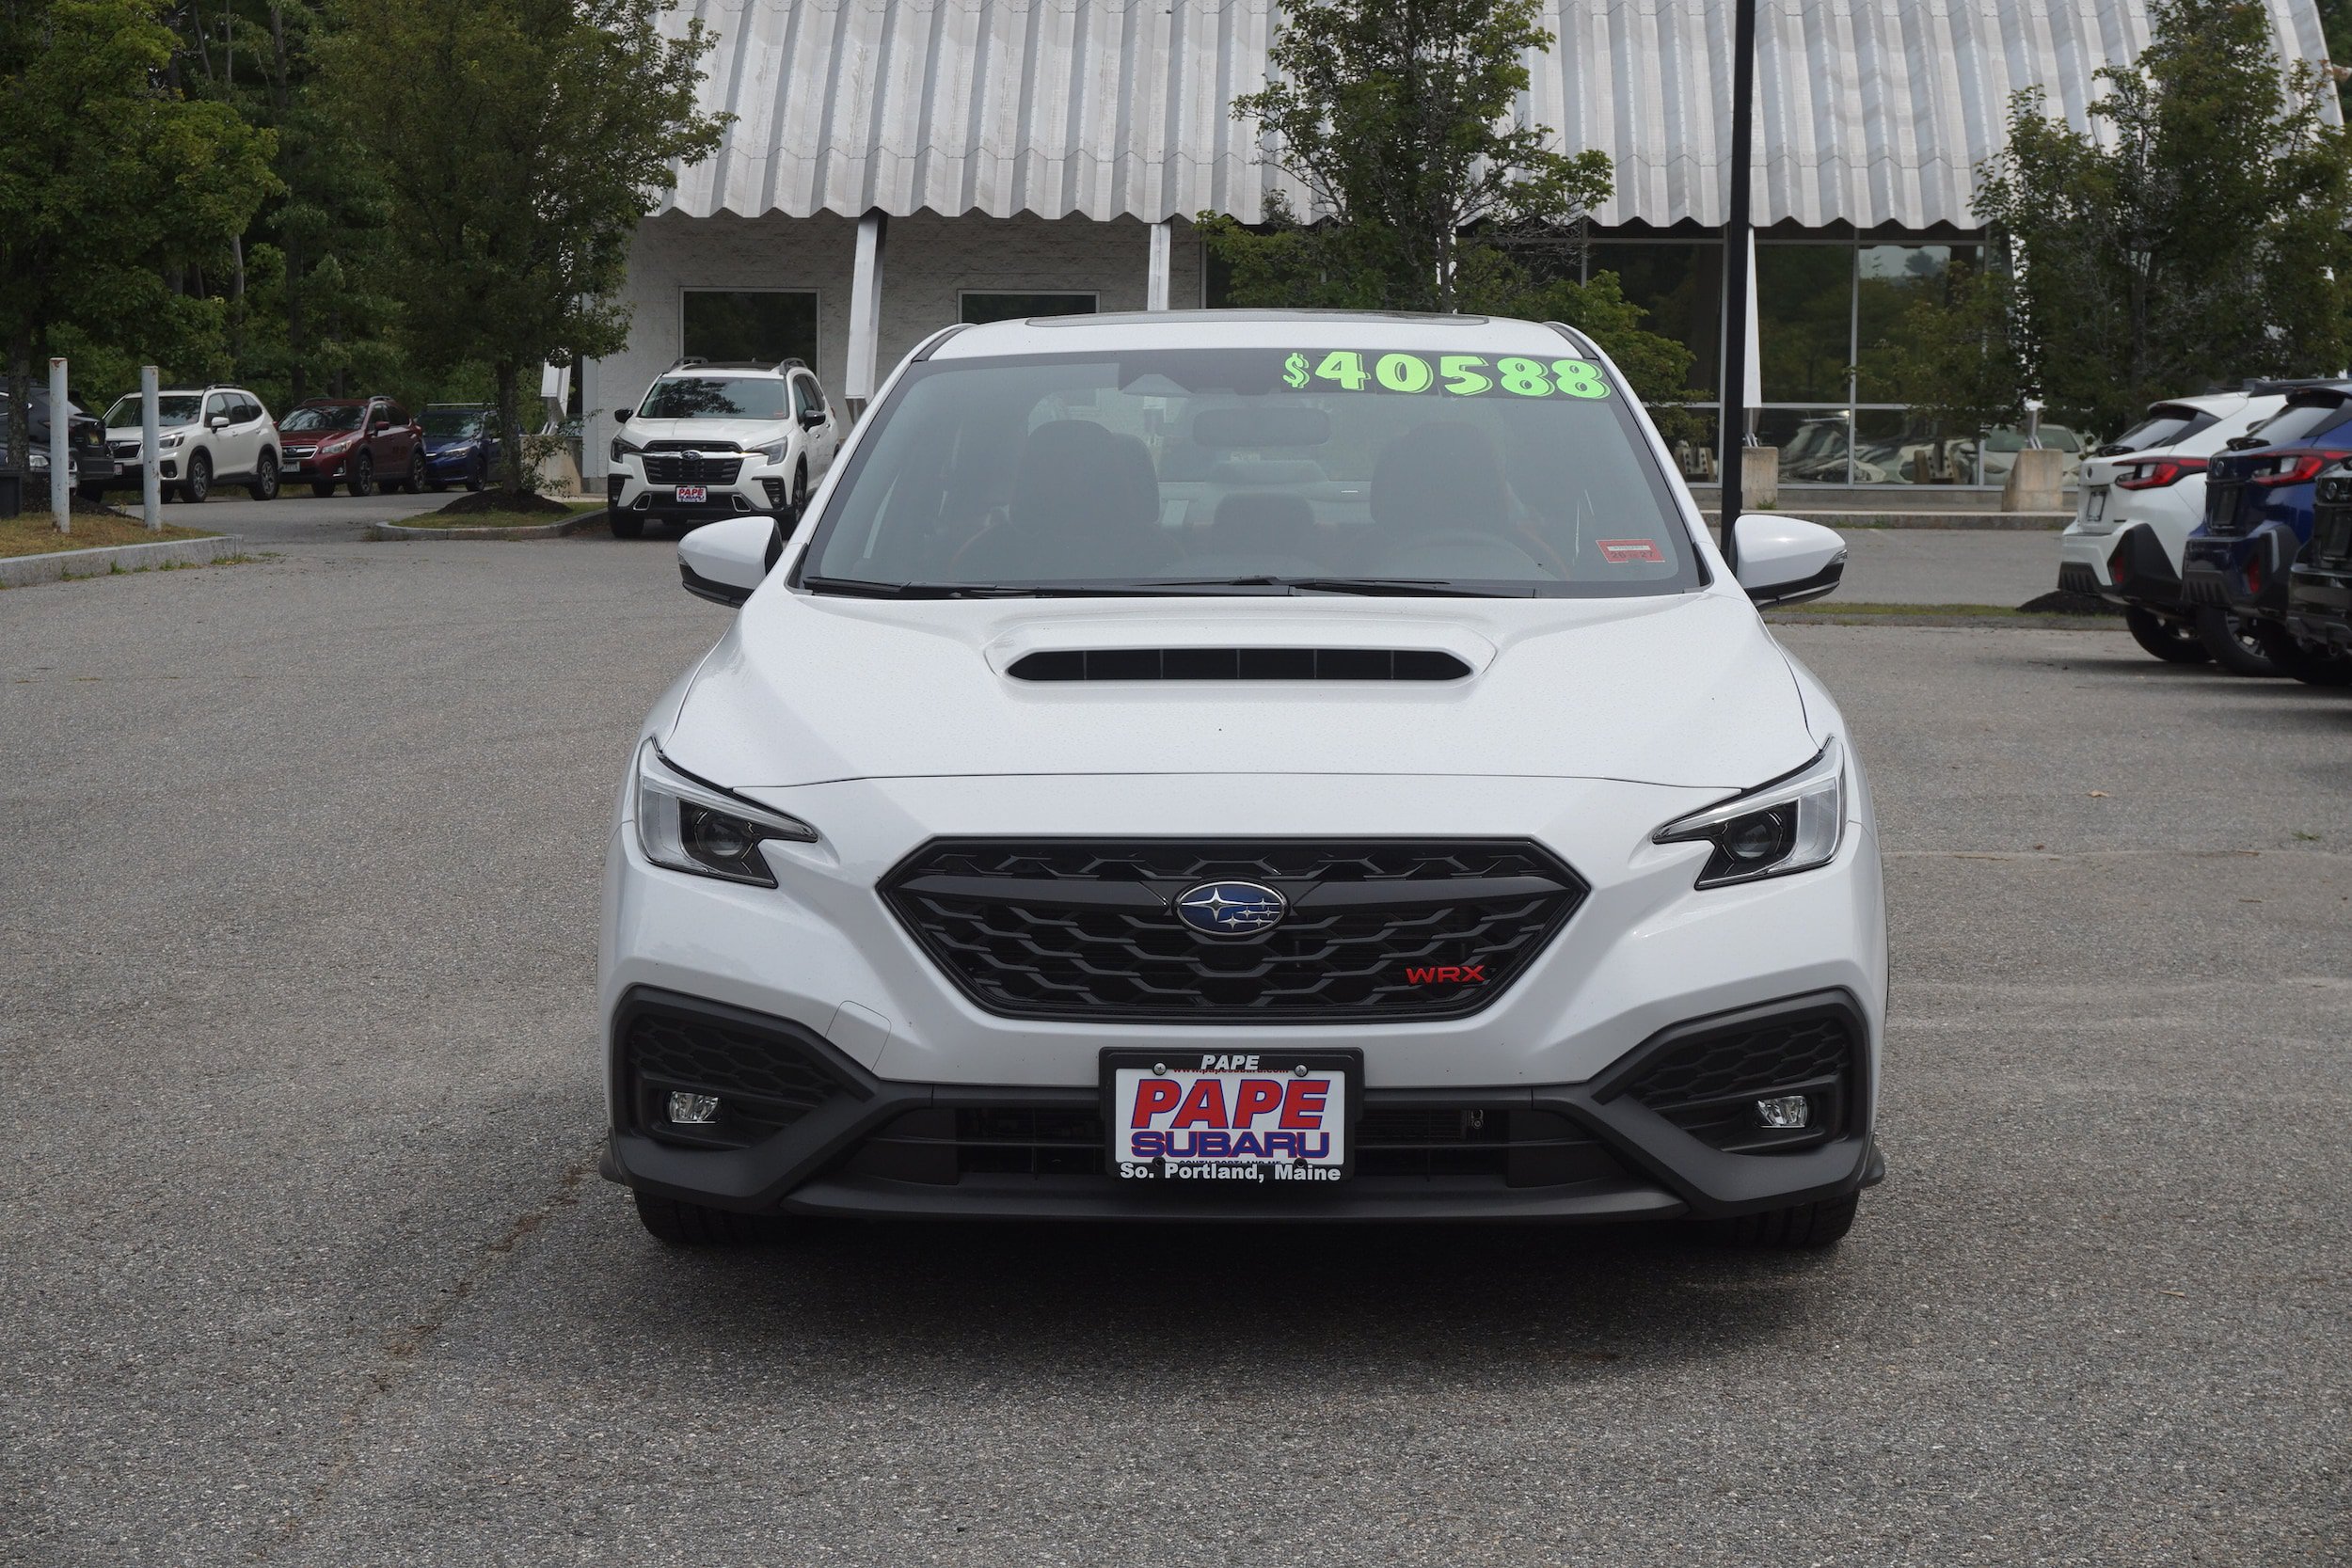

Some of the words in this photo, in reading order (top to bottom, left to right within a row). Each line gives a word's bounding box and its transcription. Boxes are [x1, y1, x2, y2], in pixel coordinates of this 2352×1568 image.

[1282, 351, 1611, 399] $40588
[1406, 965, 1485, 983] WRX
[1200, 1054, 1260, 1070] PAPE
[1131, 1079, 1330, 1130] PAPE
[1131, 1131, 1330, 1159] SUBARU
[1120, 1162, 1154, 1179] So.
[1165, 1163, 1264, 1183] Portland,
[1275, 1165, 1342, 1181] Maine
